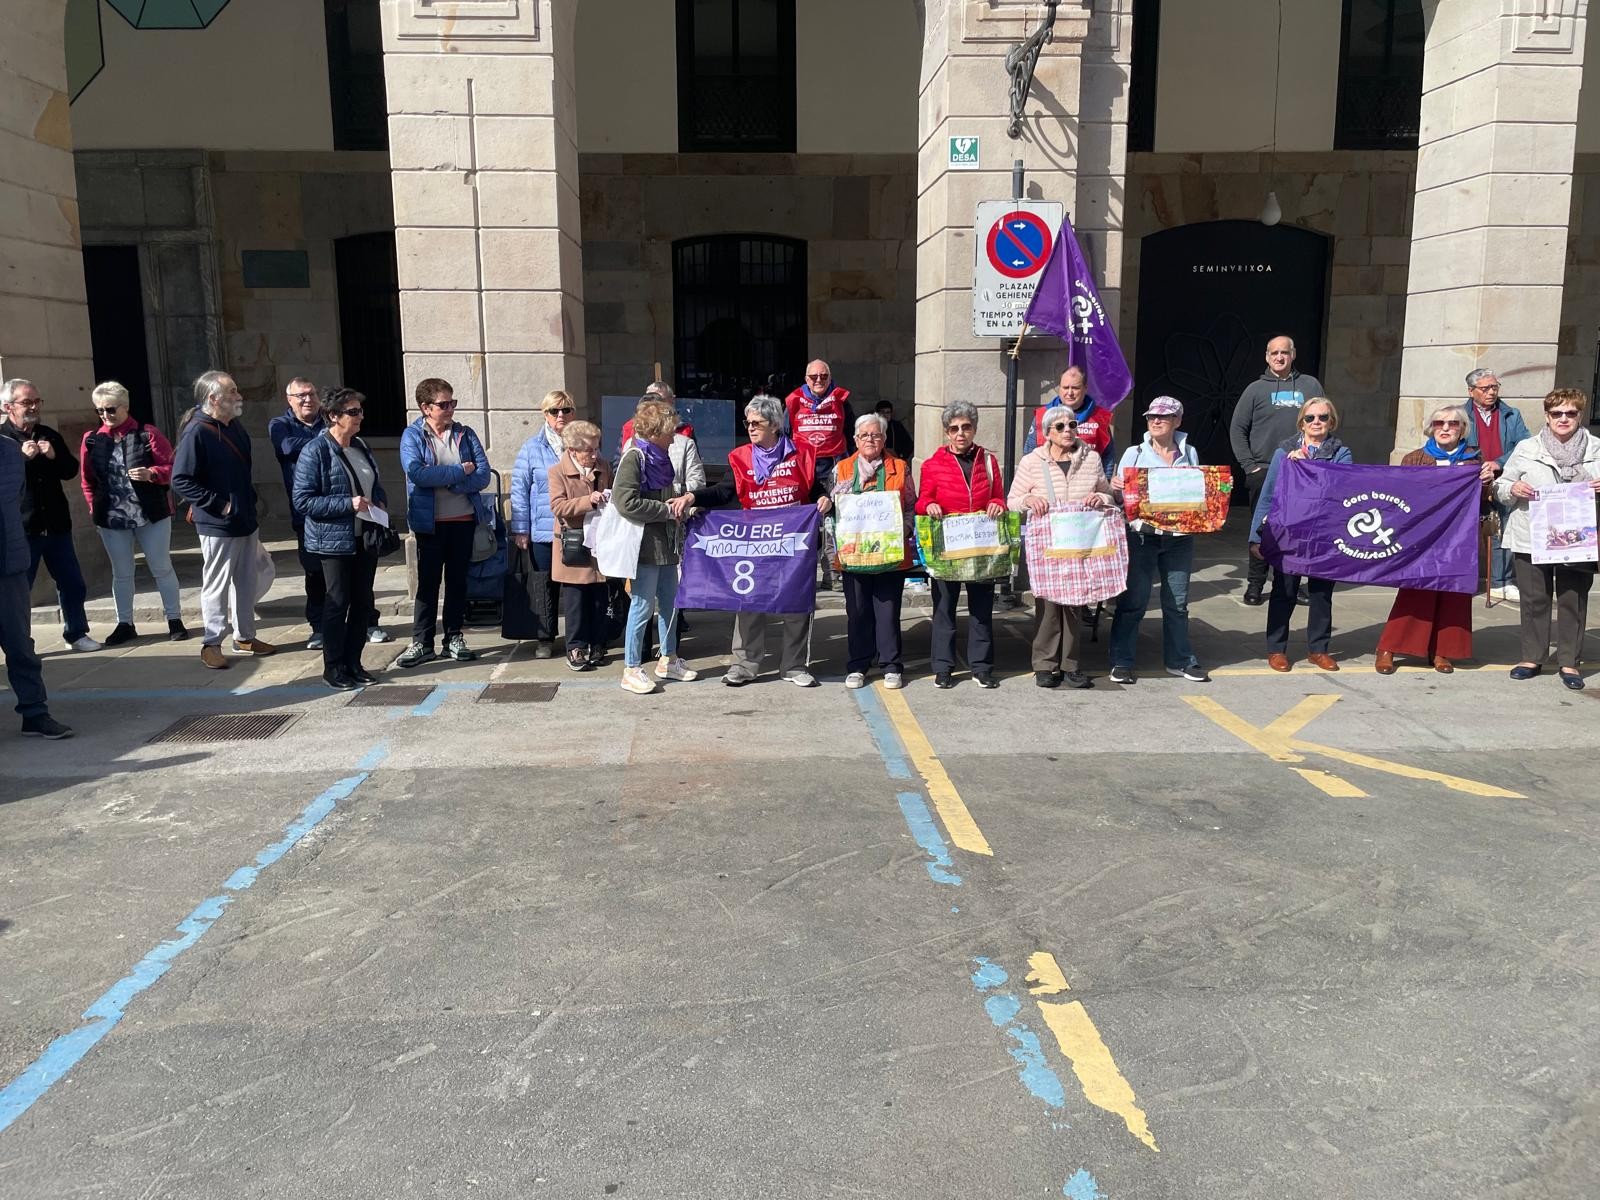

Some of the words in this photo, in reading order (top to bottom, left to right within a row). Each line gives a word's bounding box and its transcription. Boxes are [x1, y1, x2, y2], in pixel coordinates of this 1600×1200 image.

[952, 153, 976, 162] DESA
[755, 494, 794, 506] SOLDATA
[1342, 493, 1369, 508] Gora
[719, 523, 747, 539] GU
[749, 522, 784, 539] ERE
[711, 539, 790, 556] martxoak
[1333, 538, 1403, 560] feminista!!!
[731, 559, 755, 595] 8
